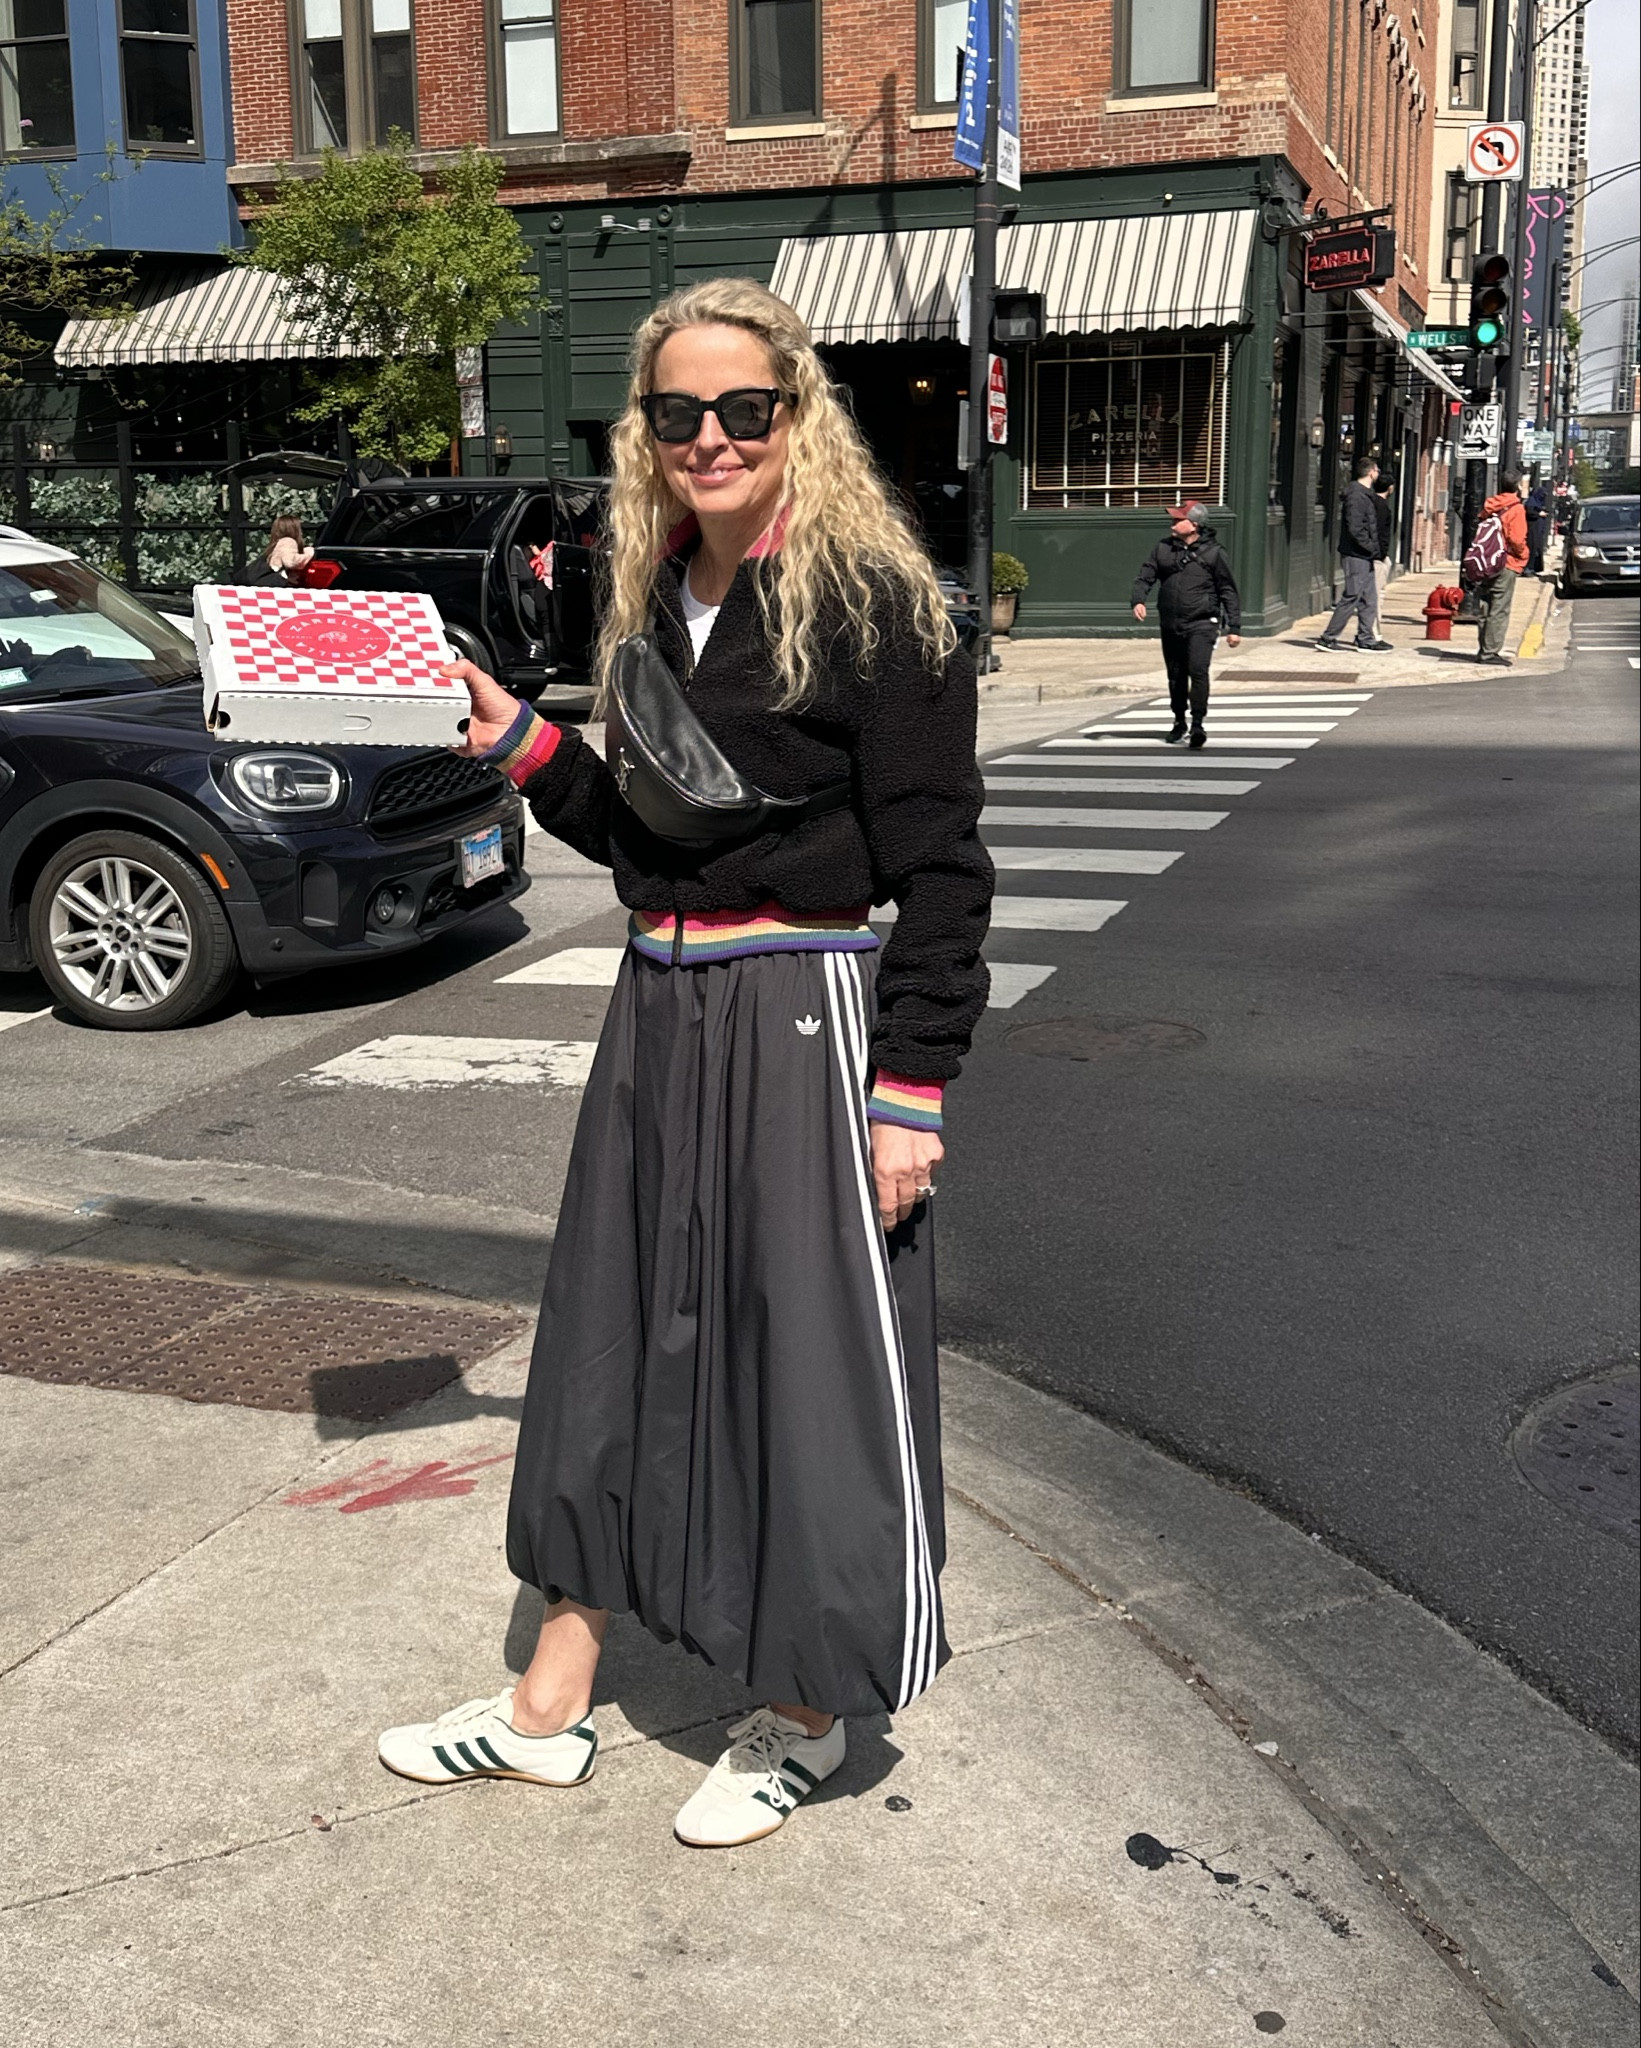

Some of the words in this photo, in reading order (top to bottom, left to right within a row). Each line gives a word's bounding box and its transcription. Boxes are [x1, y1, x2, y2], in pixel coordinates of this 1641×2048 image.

[1309, 247, 1370, 271] ZARELLA
[1418, 333, 1456, 346] WELLS
[1068, 404, 1183, 431] ZARELLA
[1464, 409, 1495, 421] ONE
[1092, 431, 1158, 442] PIZZERIA
[1462, 423, 1495, 437] WAY
[289, 618, 371, 634] ZARELLA
[295, 641, 378, 658] ZARELLA
